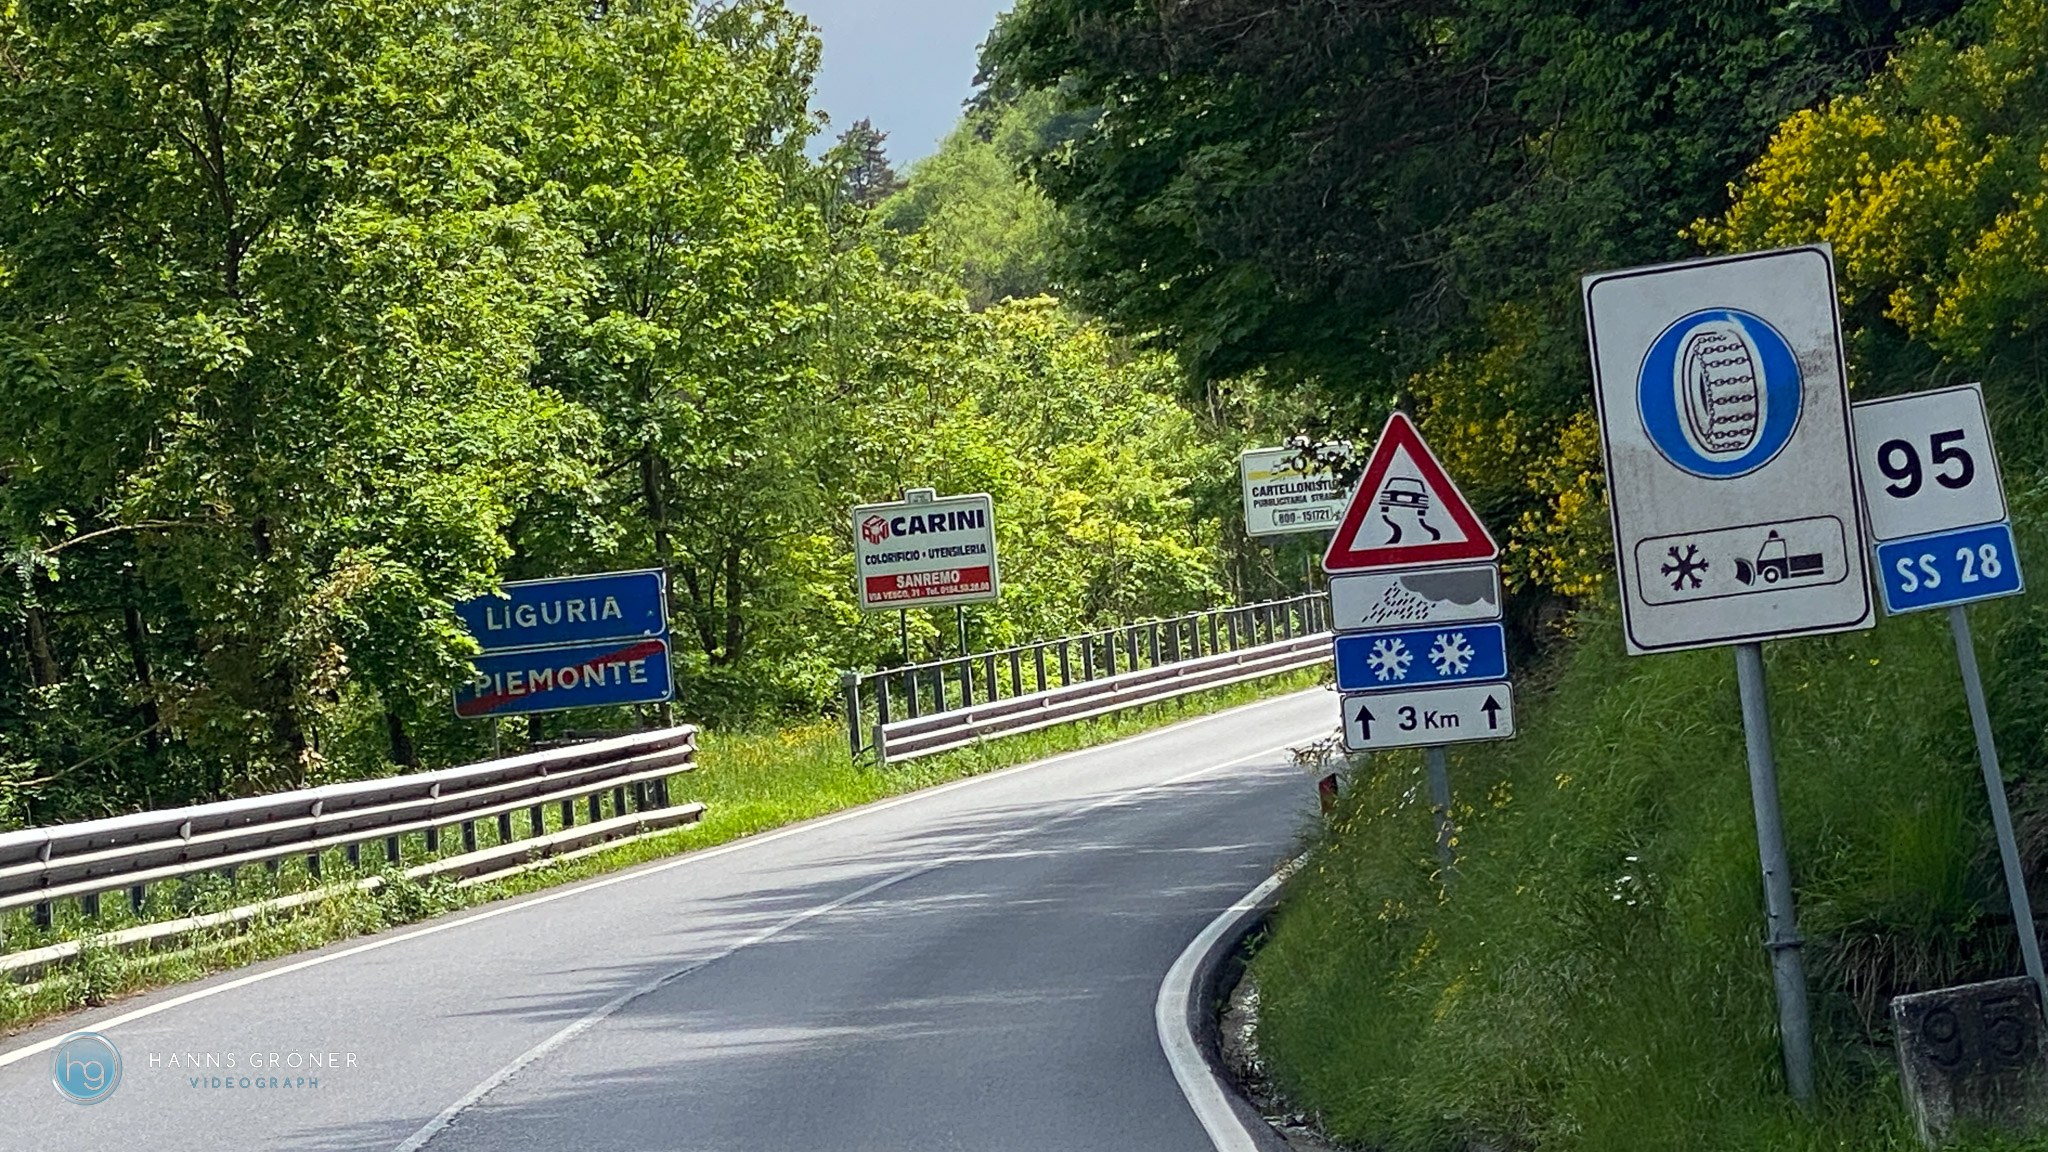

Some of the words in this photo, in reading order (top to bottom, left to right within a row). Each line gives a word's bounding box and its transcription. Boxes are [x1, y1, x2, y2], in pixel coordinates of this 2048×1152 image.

[1876, 428, 1975, 498] 95
[1252, 478, 1341, 498] CARTELLONISTI
[890, 509, 985, 536] CARINI
[865, 550, 920, 566] COLORIFICIO
[928, 543, 987, 559] UTENSILERIA
[1896, 552, 1941, 593] SS
[1956, 543, 2001, 583] 28
[896, 570, 961, 588] SANREMO
[868, 591, 882, 601] VIA
[486, 596, 622, 631] LIGURIA
[474, 659, 648, 698] PIEMONTE
[1397, 706, 1418, 731] 3
[1424, 710, 1460, 729] Km
[1922, 996, 2024, 1067] 95
